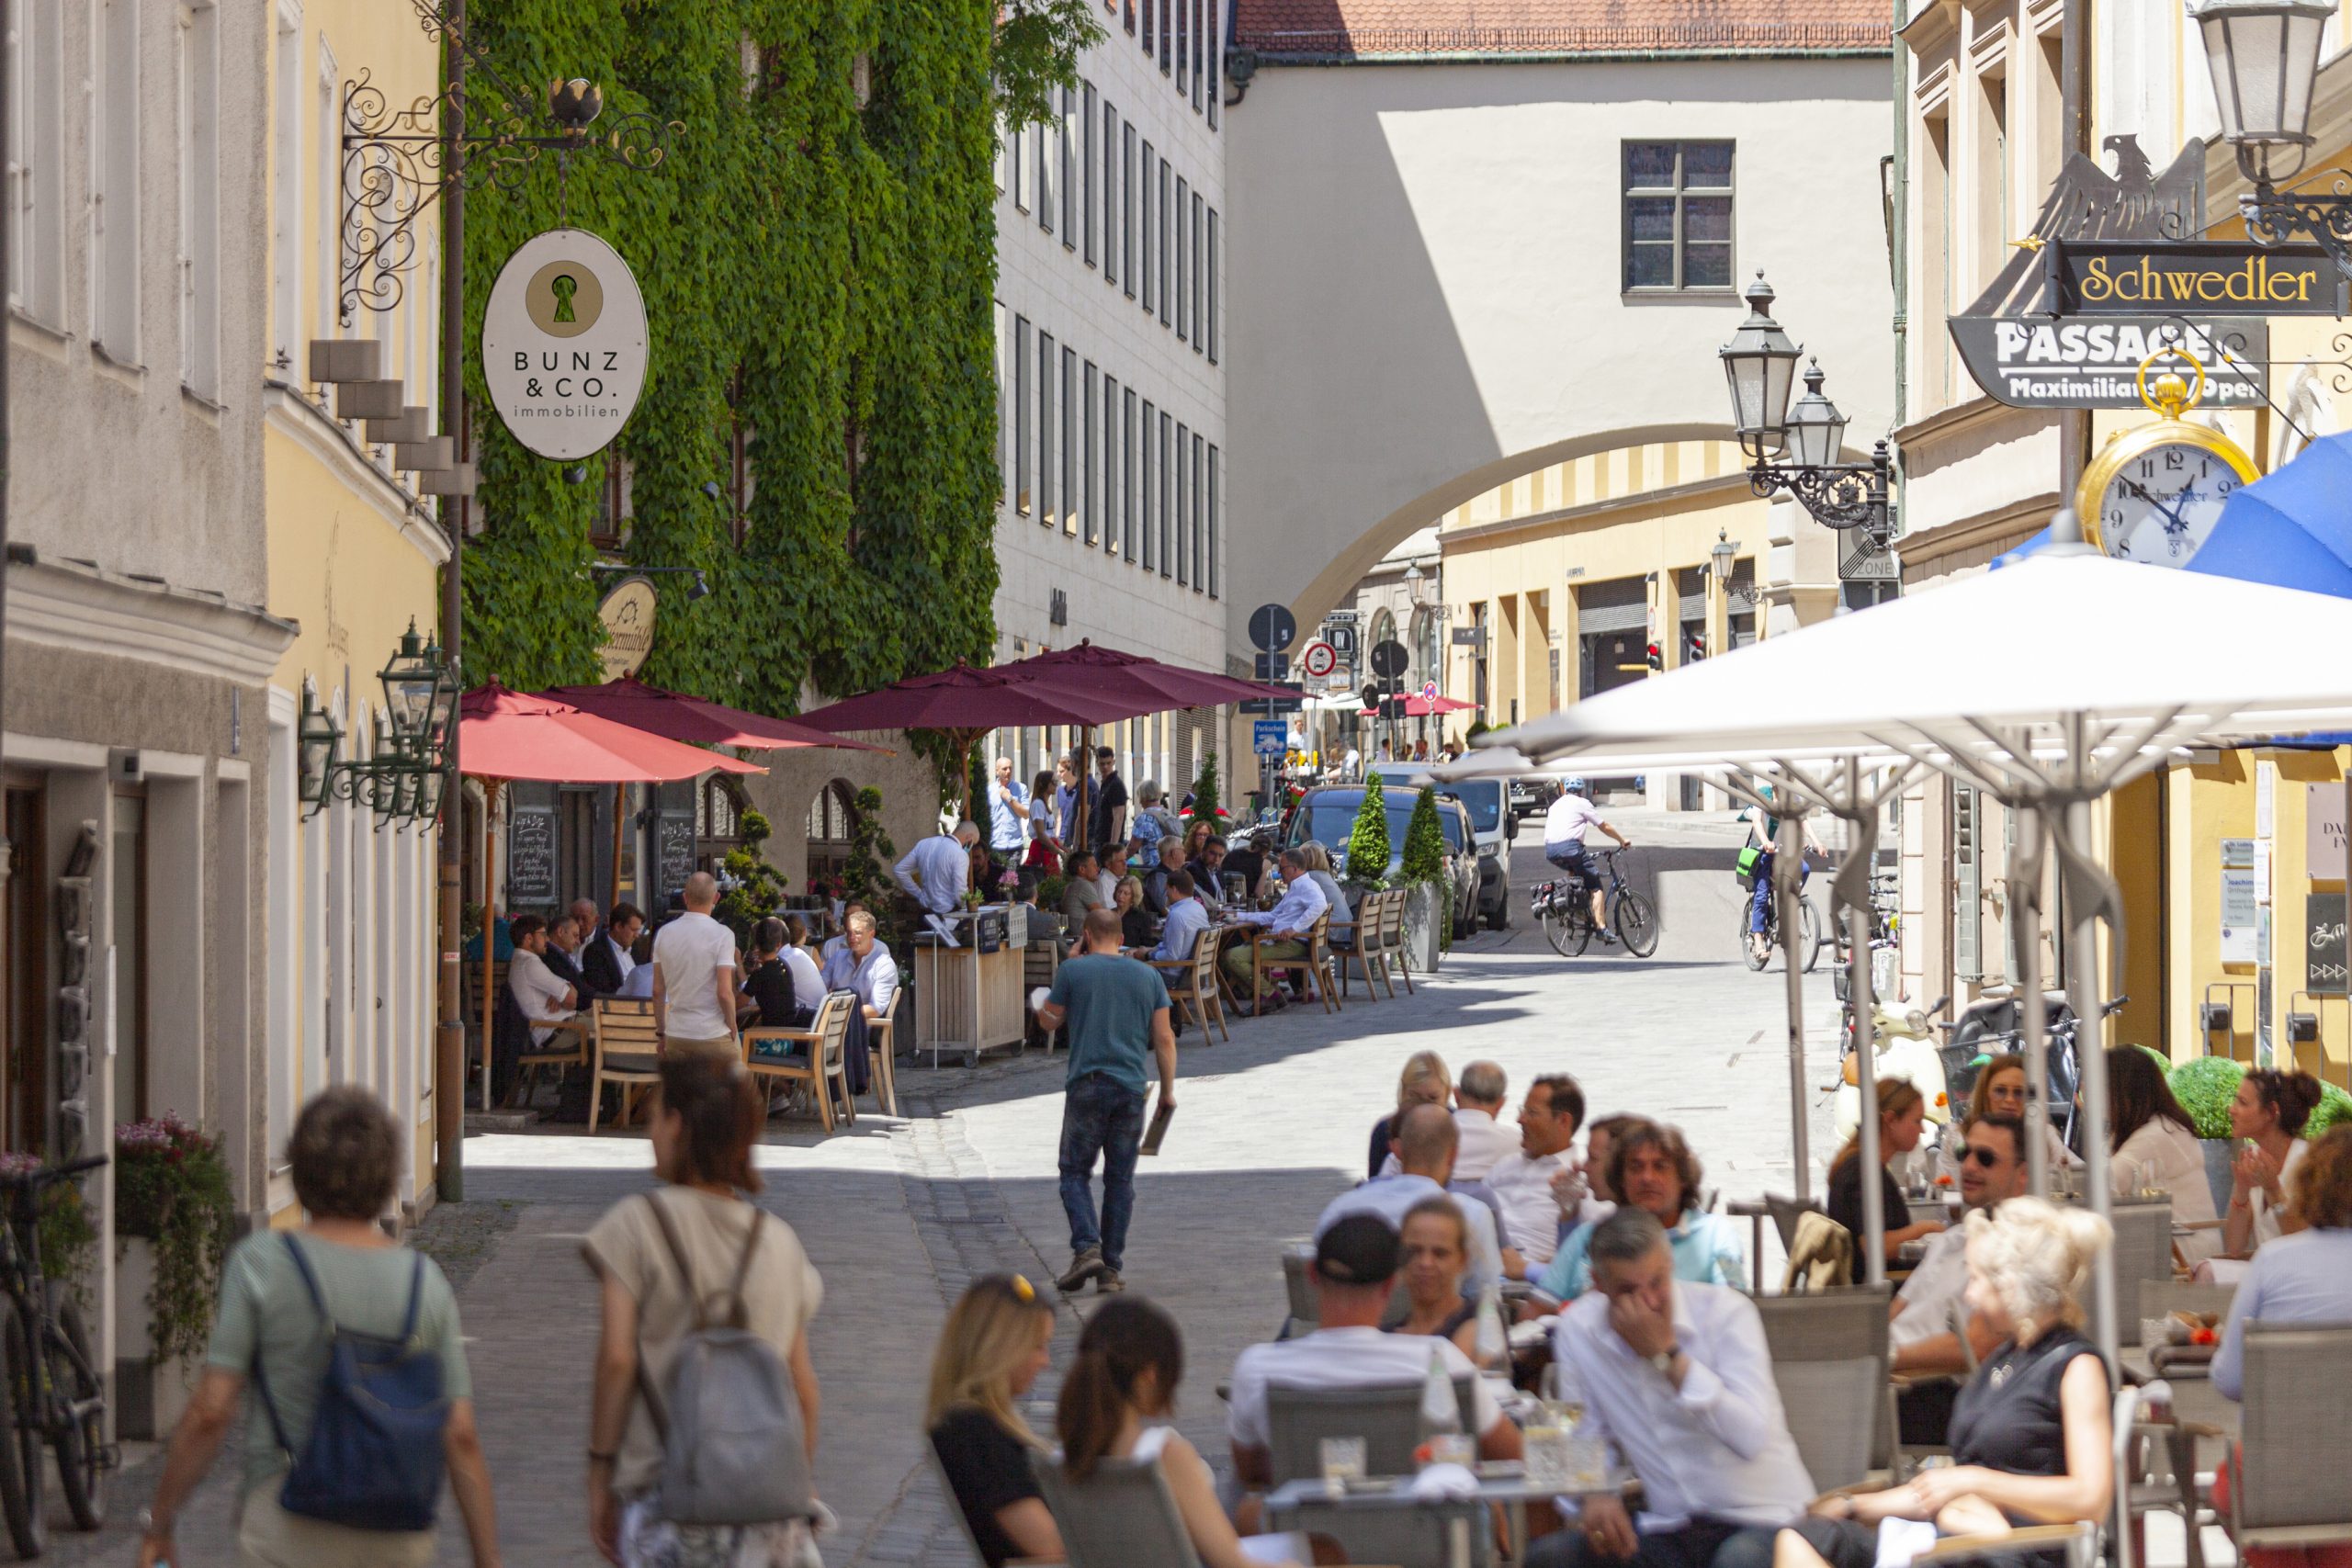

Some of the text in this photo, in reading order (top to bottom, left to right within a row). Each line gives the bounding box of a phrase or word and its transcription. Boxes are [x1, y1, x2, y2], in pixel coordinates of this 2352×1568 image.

[2080, 254, 2317, 301] Schwedler
[1994, 321, 2212, 363] PASSAGE
[514, 352, 618, 370] BUNZ
[526, 378, 617, 397] &CO.
[514, 405, 619, 417] immobilien
[2141, 458, 2154, 478] 11
[2165, 450, 2184, 470] 12
[2200, 458, 2208, 478] 1
[2117, 480, 2133, 500] 10
[2217, 479, 2232, 499] 2
[2109, 509, 2123, 529] 9
[2118, 538, 2131, 558] 8
[1856, 562, 1894, 574] ZONE
[1255, 724, 1286, 732] Parkschein
